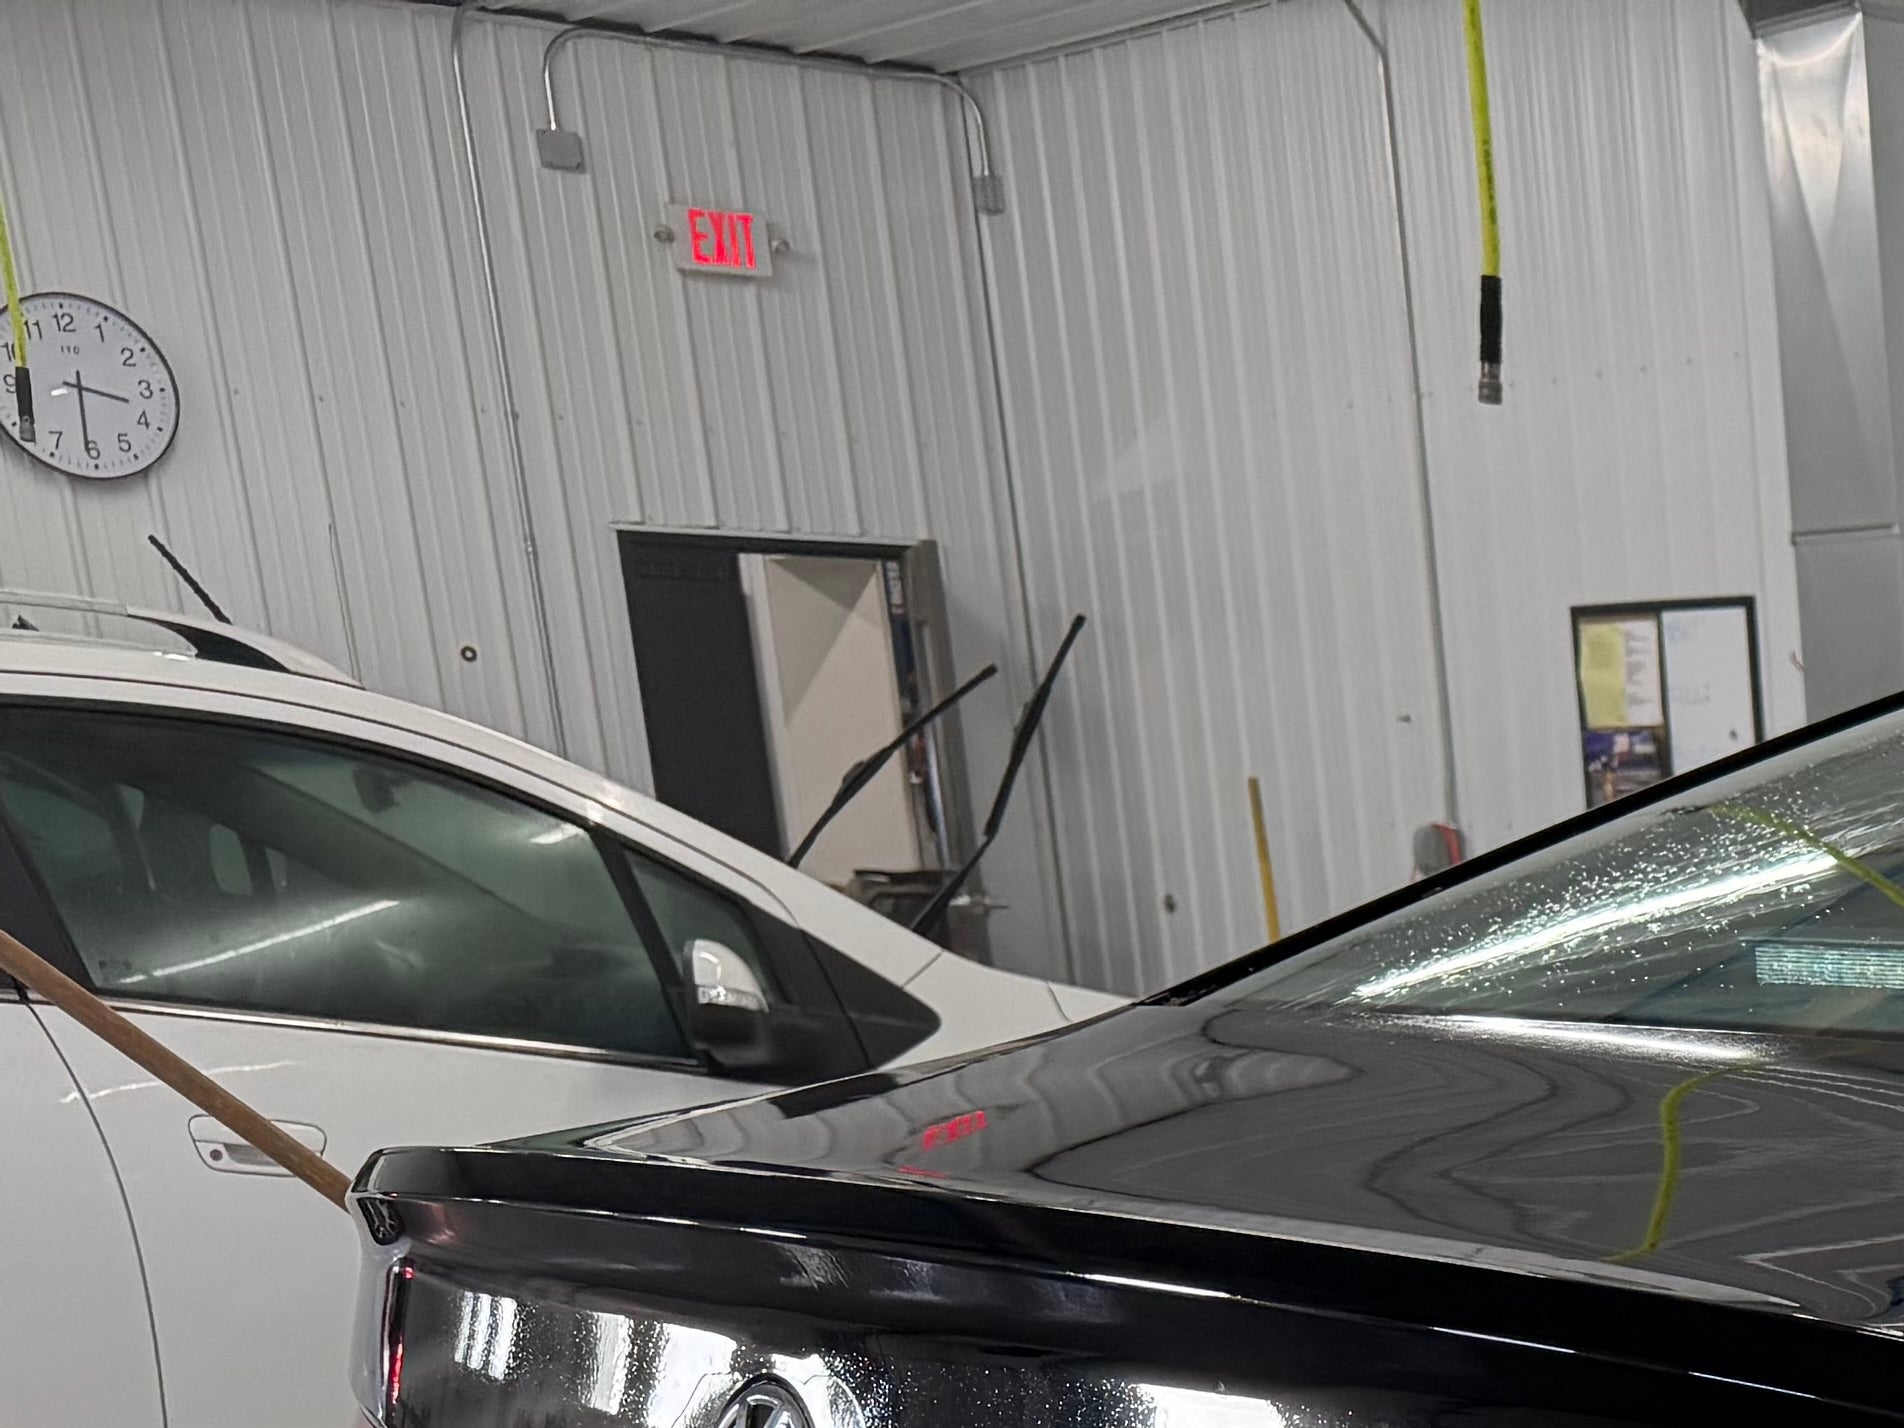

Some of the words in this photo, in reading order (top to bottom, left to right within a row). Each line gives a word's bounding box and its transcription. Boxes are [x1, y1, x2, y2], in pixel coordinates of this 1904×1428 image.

[688, 208, 756, 270] EXIT
[23, 320, 43, 340] 11
[52, 312, 77, 333] 12
[95, 322, 105, 343] 1
[120, 347, 137, 368] 2
[3, 373, 17, 394] 9
[137, 379, 154, 400] 3
[137, 410, 151, 430] 4
[48, 430, 63, 450] 7
[86, 440, 101, 461] 6
[117, 433, 132, 453] 5
